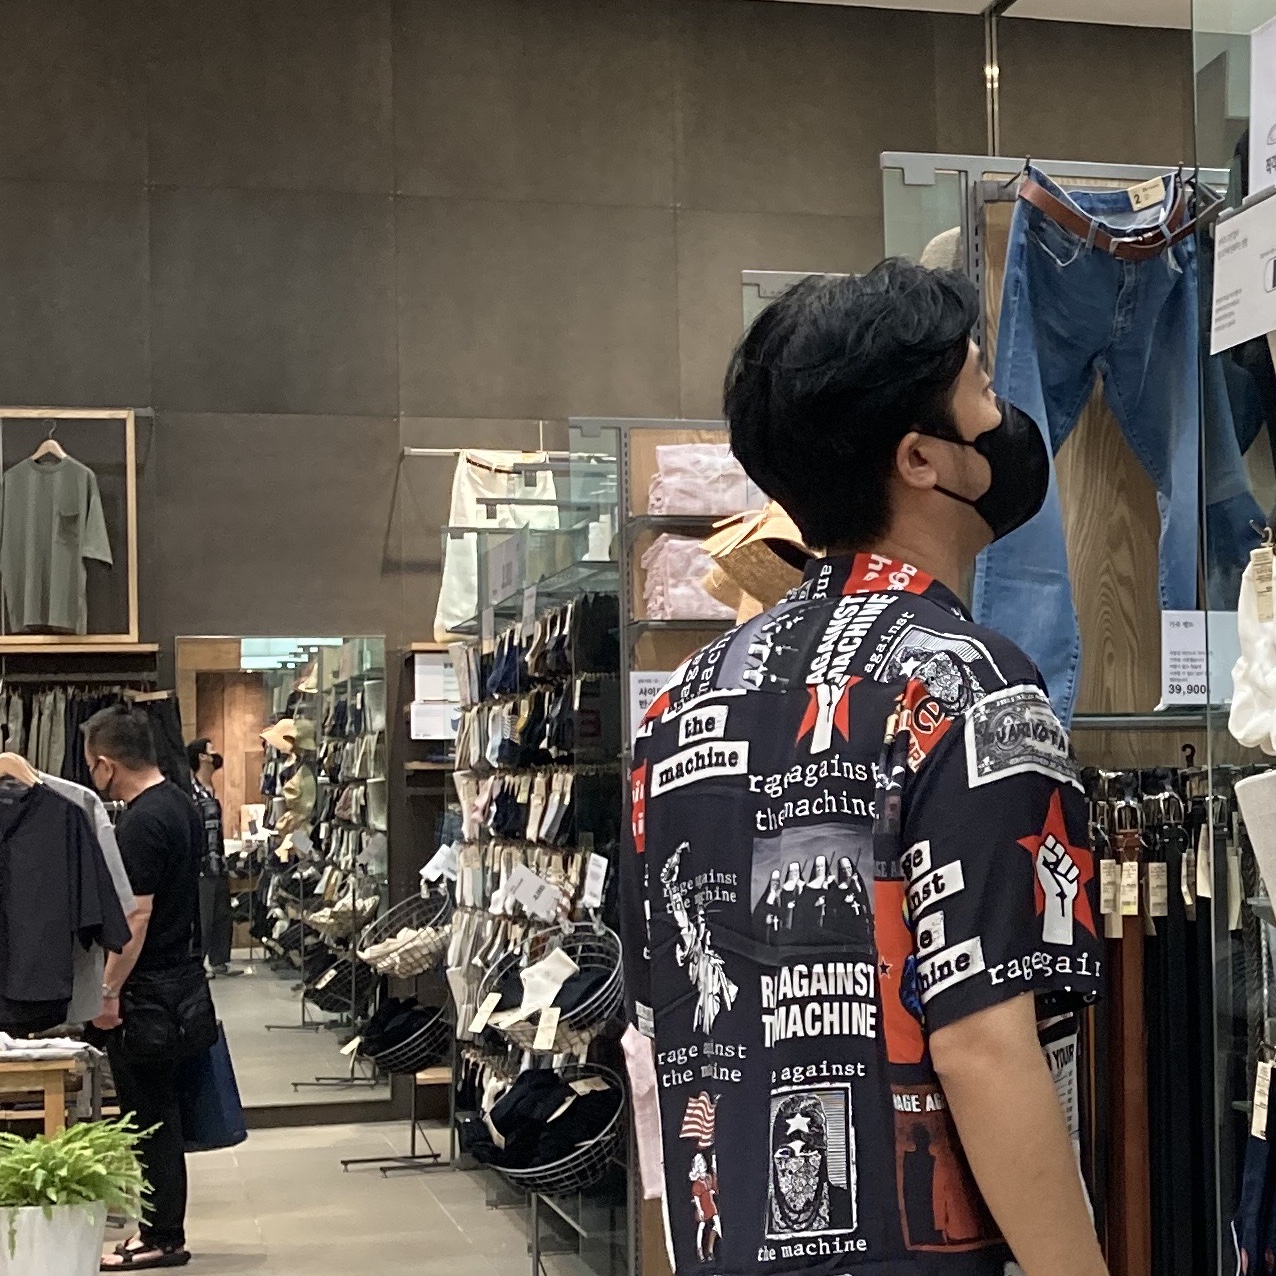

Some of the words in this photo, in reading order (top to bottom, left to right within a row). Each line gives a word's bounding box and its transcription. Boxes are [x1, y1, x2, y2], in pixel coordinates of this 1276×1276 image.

[805, 595, 867, 685] AGAINST
[864, 611, 915, 673] against
[685, 717, 716, 739] the
[659, 747, 739, 788] machine
[666, 898, 691, 914] te
[777, 962, 875, 1001] AGAINST
[657, 1044, 699, 1065] rage
[662, 1069, 694, 1088] the
[780, 1060, 867, 1083] against
[781, 1238, 868, 1258] machine
